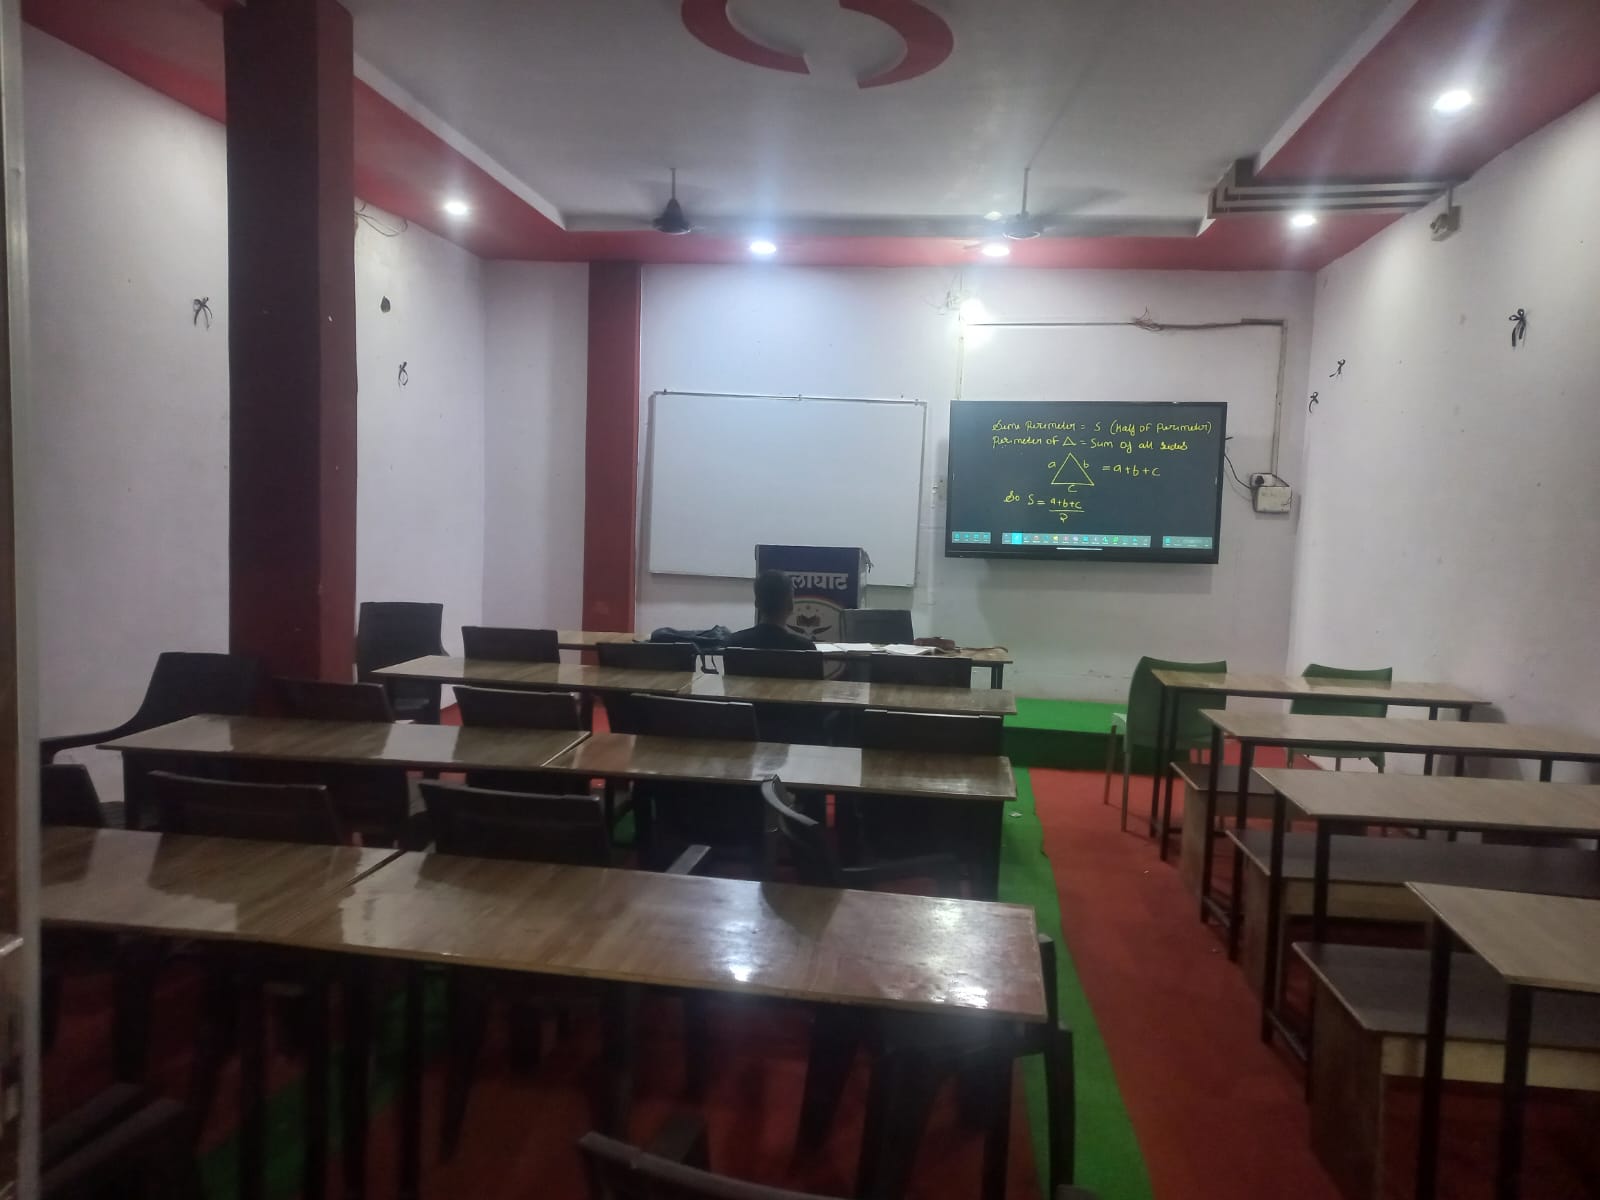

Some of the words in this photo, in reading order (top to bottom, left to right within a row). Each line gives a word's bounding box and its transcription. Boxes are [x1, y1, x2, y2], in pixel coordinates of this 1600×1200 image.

[1046, 434, 1060, 445] of
[1138, 440, 1153, 450] all
[1083, 460, 1089, 468] b
